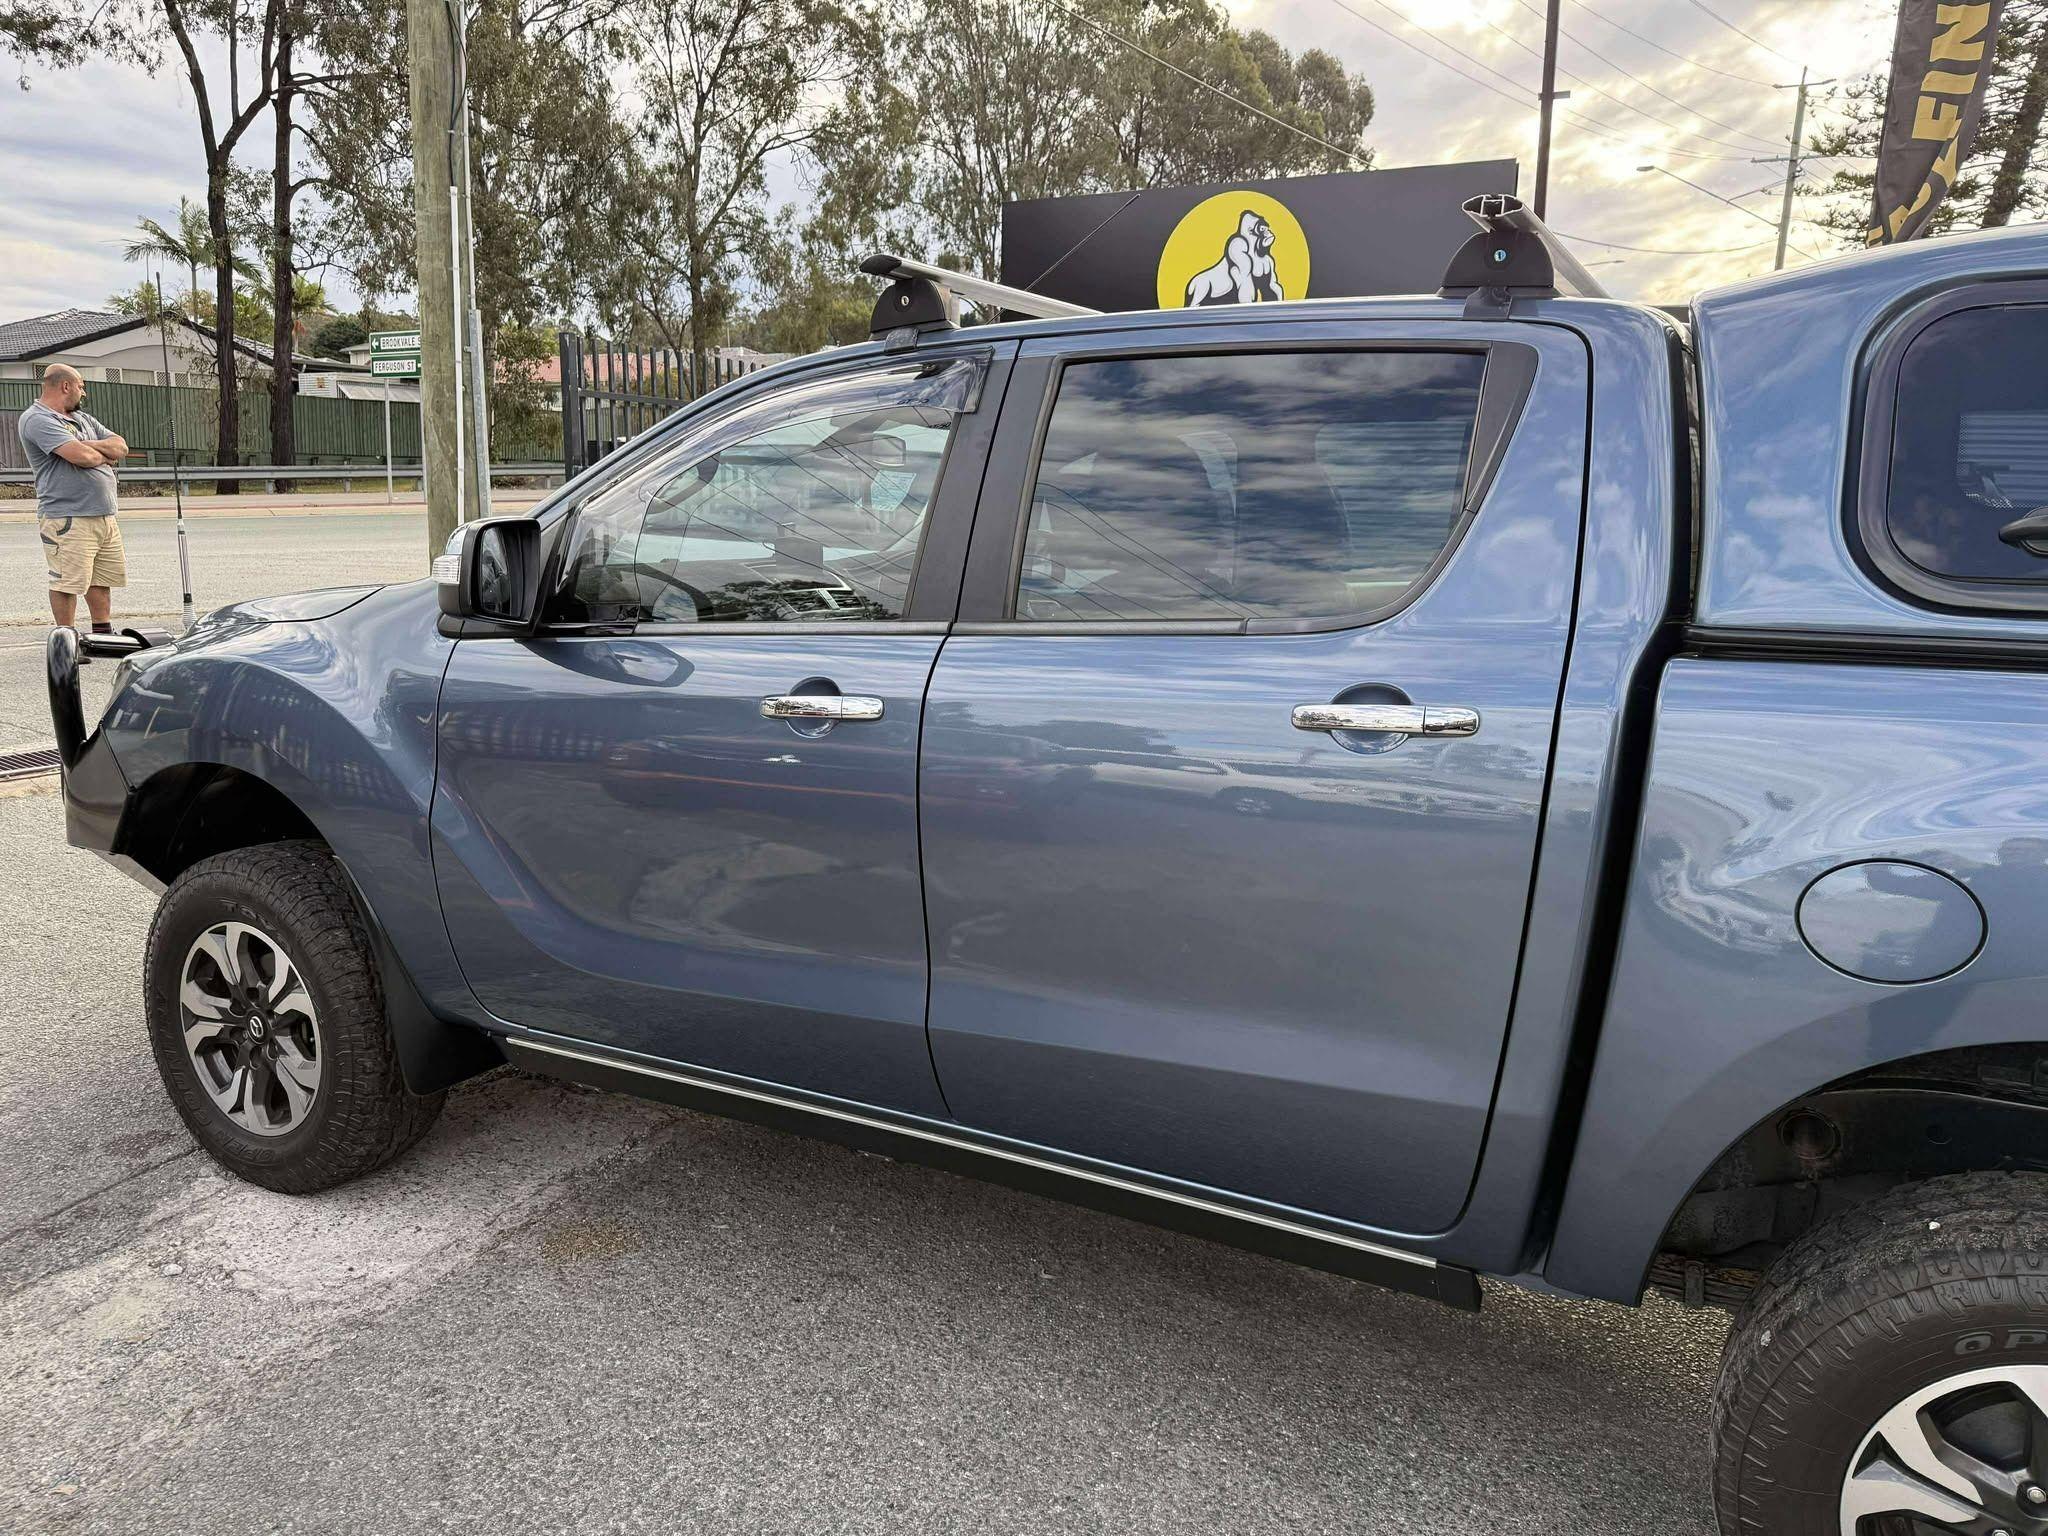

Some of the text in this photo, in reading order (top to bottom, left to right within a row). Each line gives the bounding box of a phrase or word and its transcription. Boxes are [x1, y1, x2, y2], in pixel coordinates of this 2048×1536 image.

[381, 336, 415, 348] BROOKVALE
[374, 361, 414, 371] FERGUSON ST
